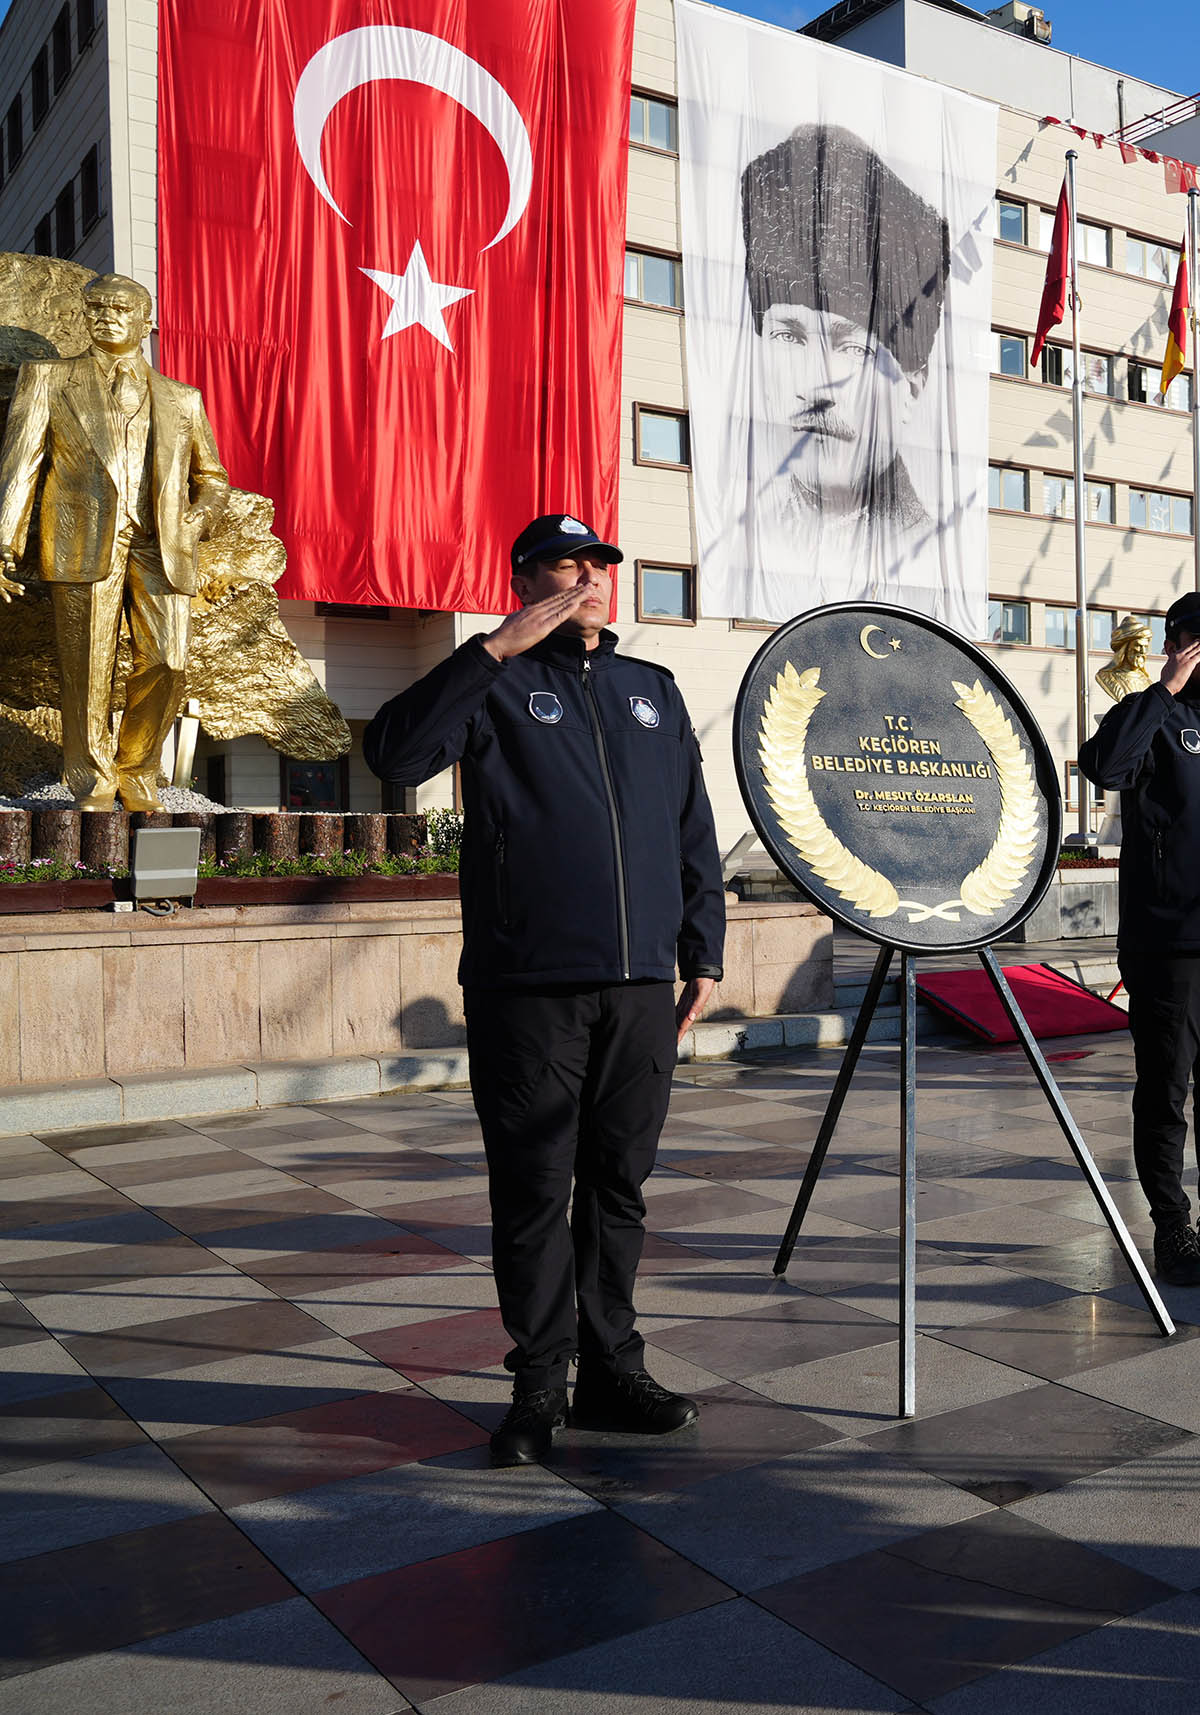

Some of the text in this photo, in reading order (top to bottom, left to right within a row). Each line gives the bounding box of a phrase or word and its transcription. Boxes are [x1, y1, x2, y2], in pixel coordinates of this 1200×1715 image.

[884, 716, 913, 731] T.C.
[858, 736, 941, 755] KEÇİÖREN
[811, 755, 992, 779] BELEDİYE BAŞKANLIĞI
[855, 789, 974, 804] Dr. MESUT ÖZARSLAN
[873, 804, 910, 814] KEÇİÖREN
[911, 805, 945, 814] BELEDİYE
[946, 806, 977, 815] BAŞKANI
